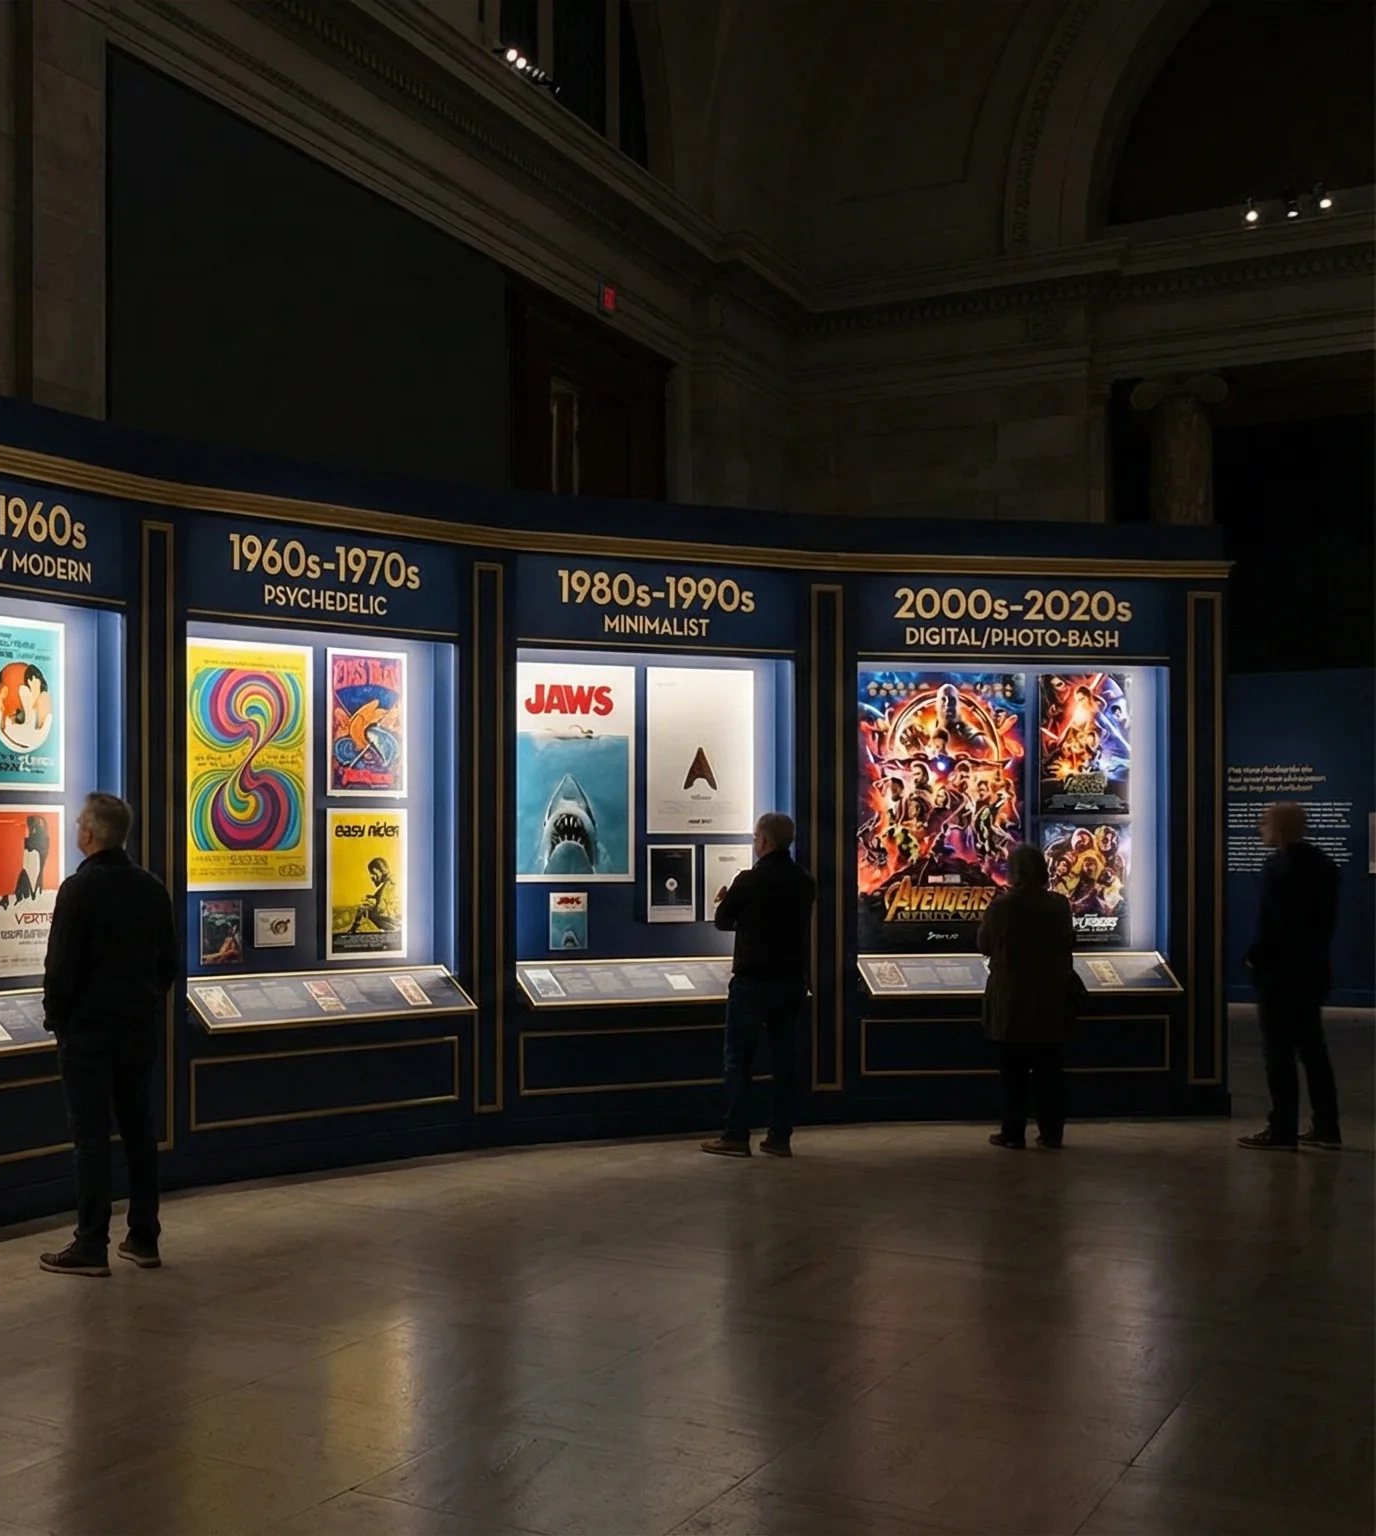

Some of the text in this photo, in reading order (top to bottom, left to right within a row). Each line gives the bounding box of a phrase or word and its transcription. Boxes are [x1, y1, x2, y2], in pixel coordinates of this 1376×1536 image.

[12, 552, 92, 584] MODERN
[229, 533, 422, 590] 1960s-1970s
[264, 584, 388, 616] PSYCHEDELIC
[557, 569, 756, 613] 1980s-1990s
[893, 587, 1133, 623] 2000s-2020s
[604, 614, 710, 637] MINIMALIST
[905, 626, 1120, 649] DIGITAL/PHOTO-BASH
[524, 683, 614, 716] JAWS
[334, 824, 365, 838] easy
